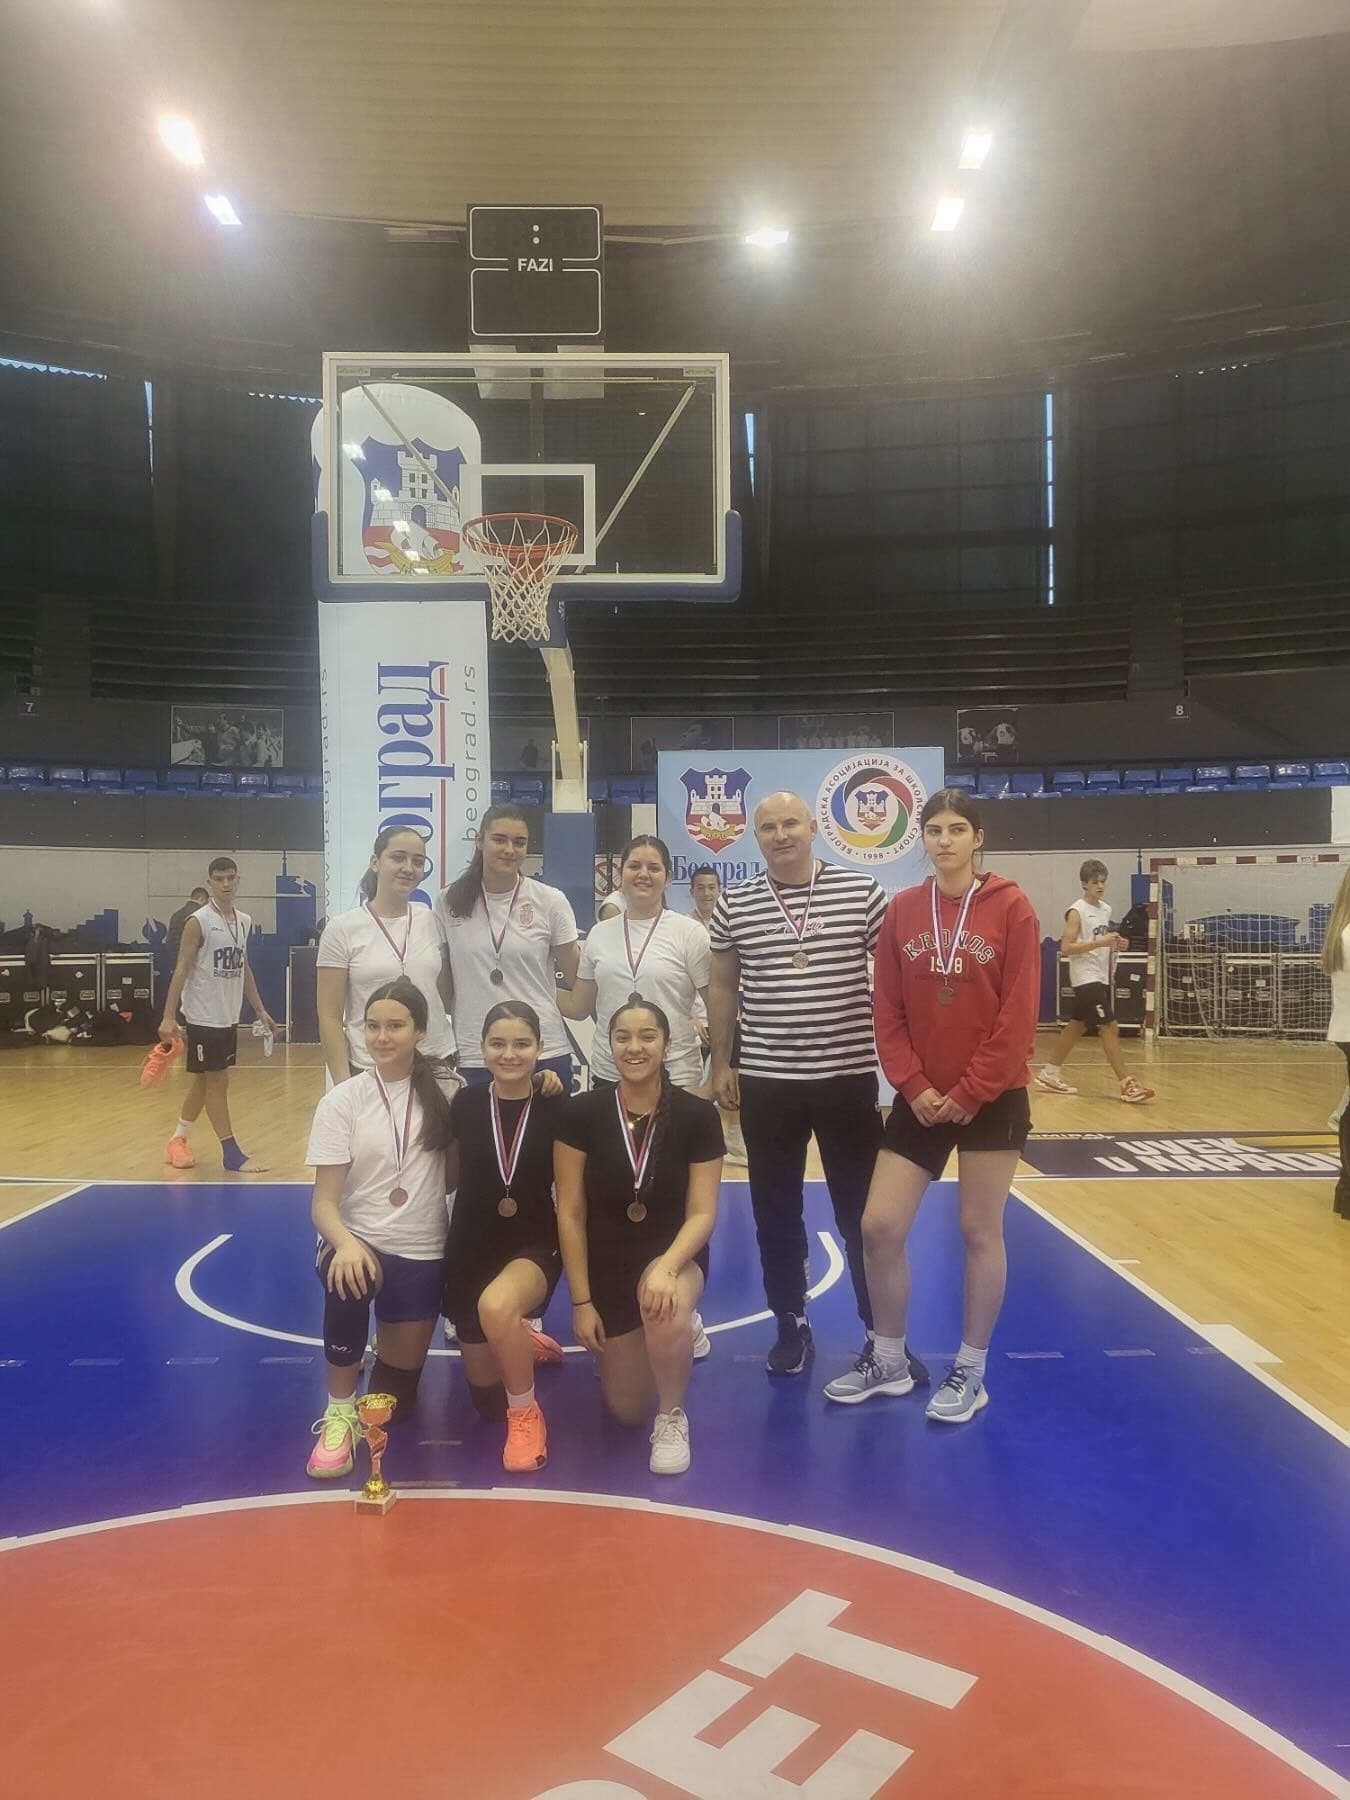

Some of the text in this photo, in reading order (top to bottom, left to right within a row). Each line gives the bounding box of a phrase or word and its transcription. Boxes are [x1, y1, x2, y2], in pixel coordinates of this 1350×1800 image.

[517, 258, 553, 272] FAZI
[25, 702, 34, 713] 7
[1175, 705, 1185, 716] 8
[863, 852, 885, 860] 1998
[929, 956, 963, 974] 198
[1115, 1138, 1267, 1156] UVEK
[1094, 1152, 1343, 1173] U NAPAD
[530, 1588, 979, 1800] ET
